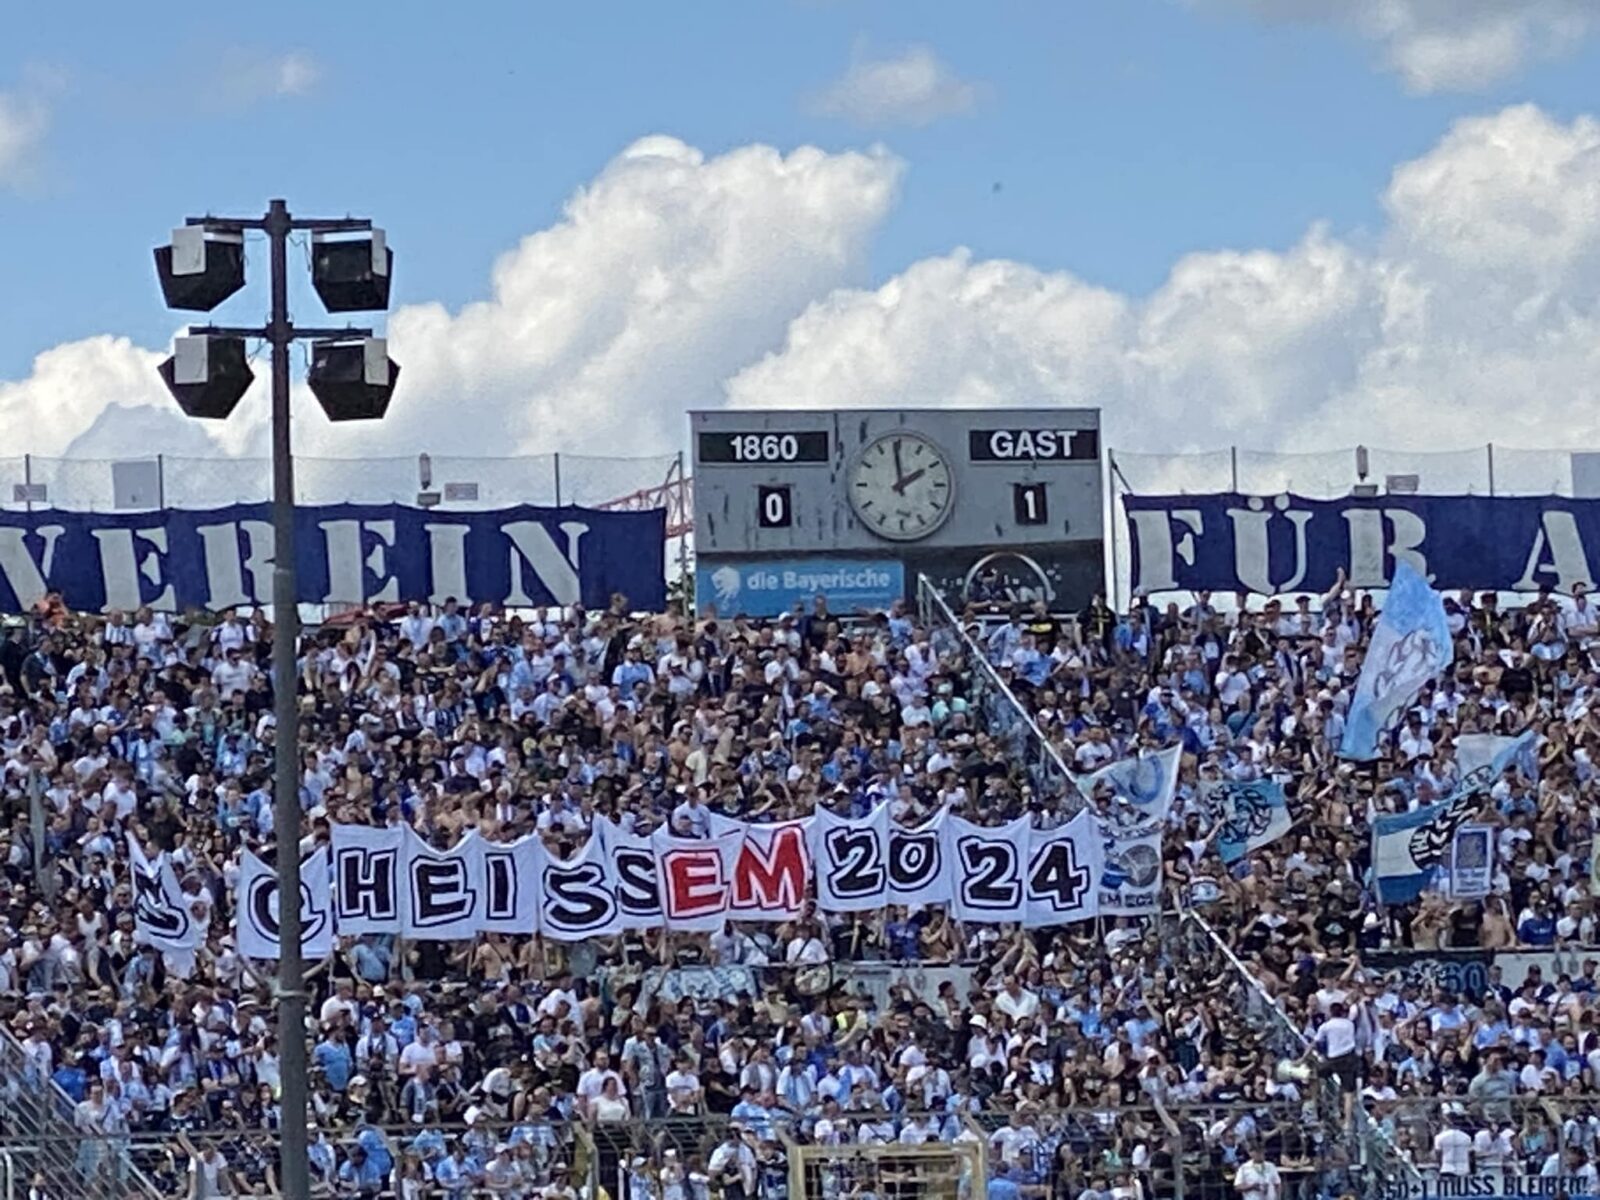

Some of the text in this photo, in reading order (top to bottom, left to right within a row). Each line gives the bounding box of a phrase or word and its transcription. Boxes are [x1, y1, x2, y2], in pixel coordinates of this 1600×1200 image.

[730, 433, 799, 461] 1860
[990, 430, 1078, 458] GAST
[765, 492, 783, 523] 0
[1023, 490, 1037, 519] 1
[1129, 491, 1437, 595] FÜR
[0, 518, 589, 612] VEREIN
[746, 568, 891, 593] die Bayerische
[1437, 1175, 1494, 1196] MUSS
